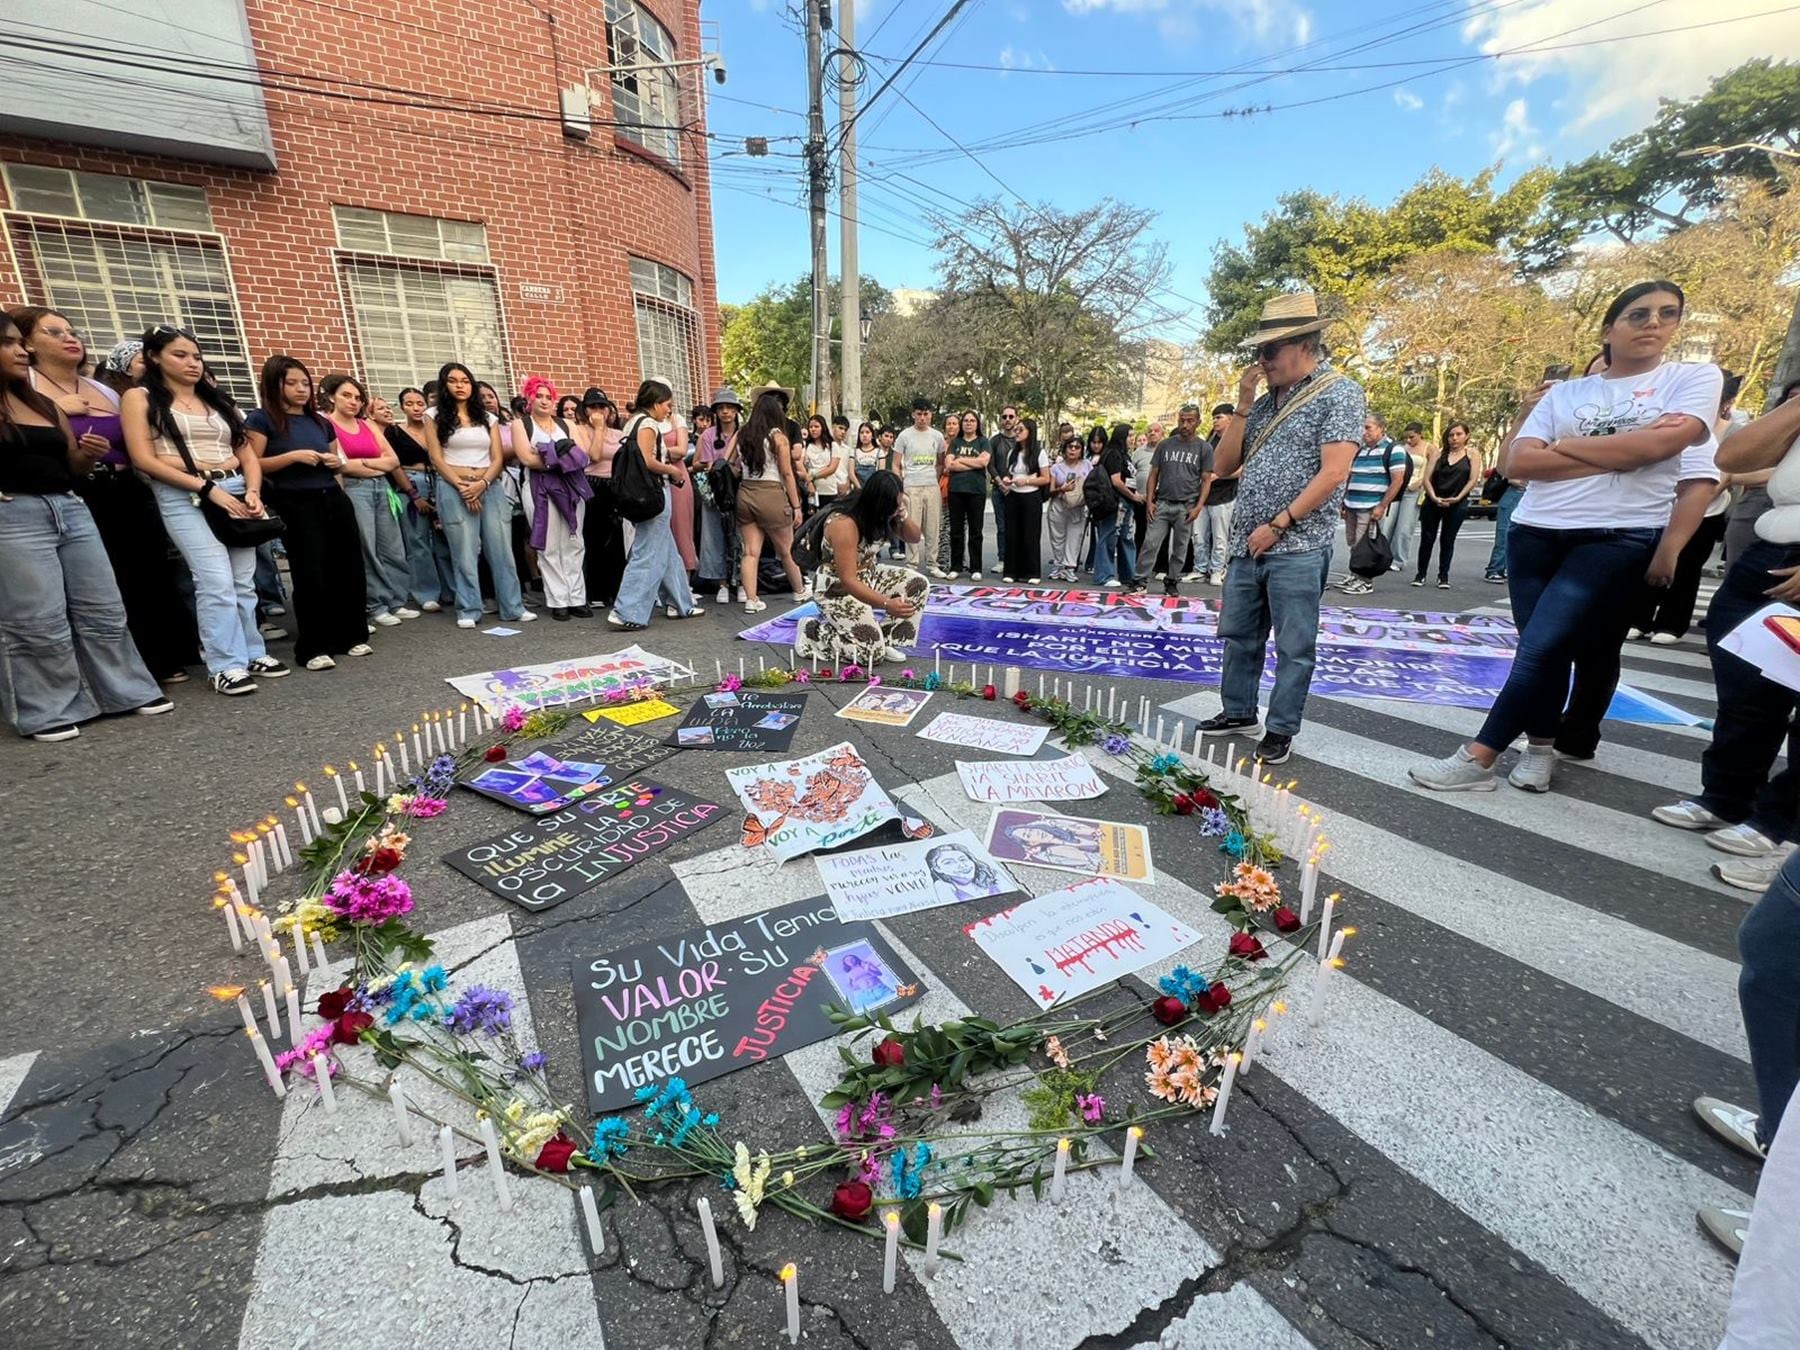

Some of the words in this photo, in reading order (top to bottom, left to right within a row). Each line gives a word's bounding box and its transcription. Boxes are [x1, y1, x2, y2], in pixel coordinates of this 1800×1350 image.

[1164, 450, 1198, 465] AMIRI
[1006, 649, 1041, 659] LA
[1027, 641, 1087, 652] POR
[1096, 647, 1164, 660] ELLA
[1171, 653, 1192, 662] Y
[1111, 640, 1155, 650] NO
[730, 766, 759, 777] VOY
[466, 830, 535, 863] QUE
[536, 811, 577, 832] SU
[578, 781, 649, 815] ARTE
[583, 815, 619, 833] LA
[768, 826, 800, 848] VOY
[497, 814, 651, 890] OSCURIDAD
[653, 797, 686, 816] DE
[565, 803, 719, 883] INJUSTICIA
[657, 929, 747, 969] Vida
[738, 944, 790, 977] SU
[594, 992, 730, 1061] NOMBRE
[732, 963, 820, 1061] JUSTICIA
[594, 1029, 725, 1095] MERECE
